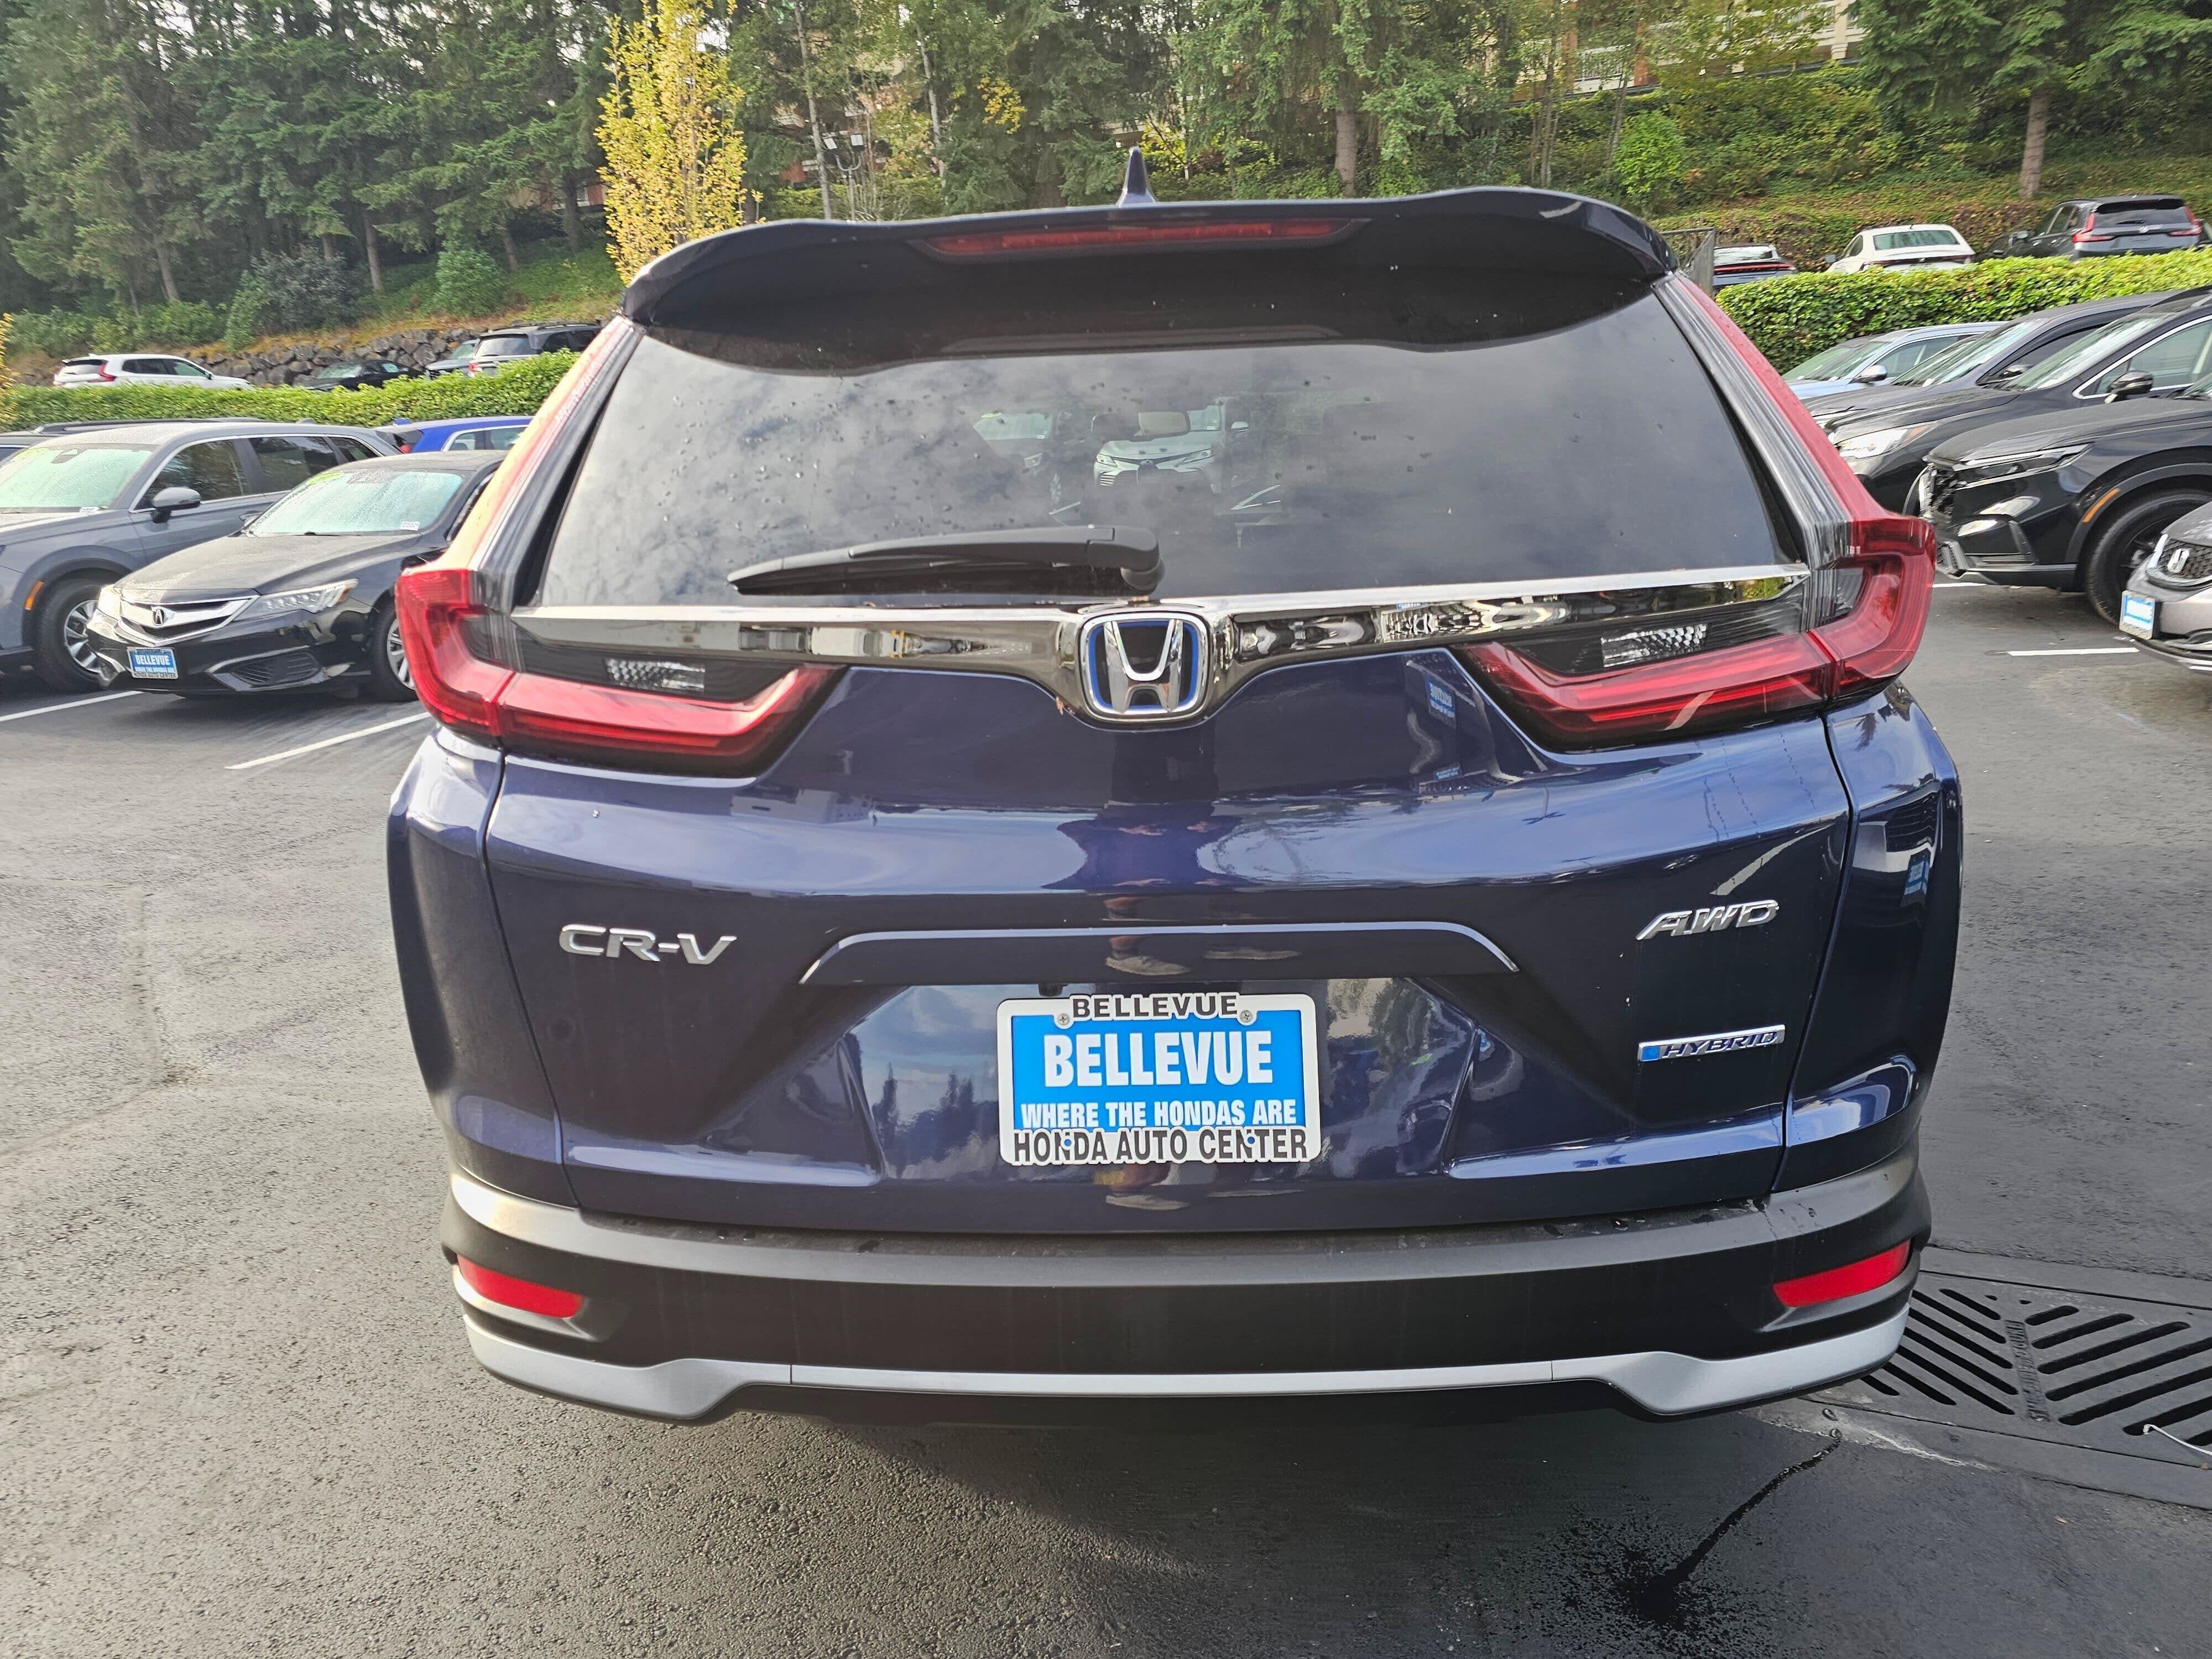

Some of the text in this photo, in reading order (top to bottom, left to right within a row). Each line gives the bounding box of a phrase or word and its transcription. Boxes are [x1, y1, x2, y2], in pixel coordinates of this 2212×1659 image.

[134, 654, 171, 665] BELLEVUE
[1635, 899, 1780, 941] AWD
[559, 924, 738, 965] CR-V
[1072, 995, 1238, 1018] BELLEVUE
[1044, 1030, 1274, 1087] BELLEVUE
[1661, 1031, 1778, 1058] HYBRID
[1021, 1099, 1296, 1129] WHERE THE HONDAS ARE
[1014, 1129, 1307, 1162] HONDA AUTO CENTER
